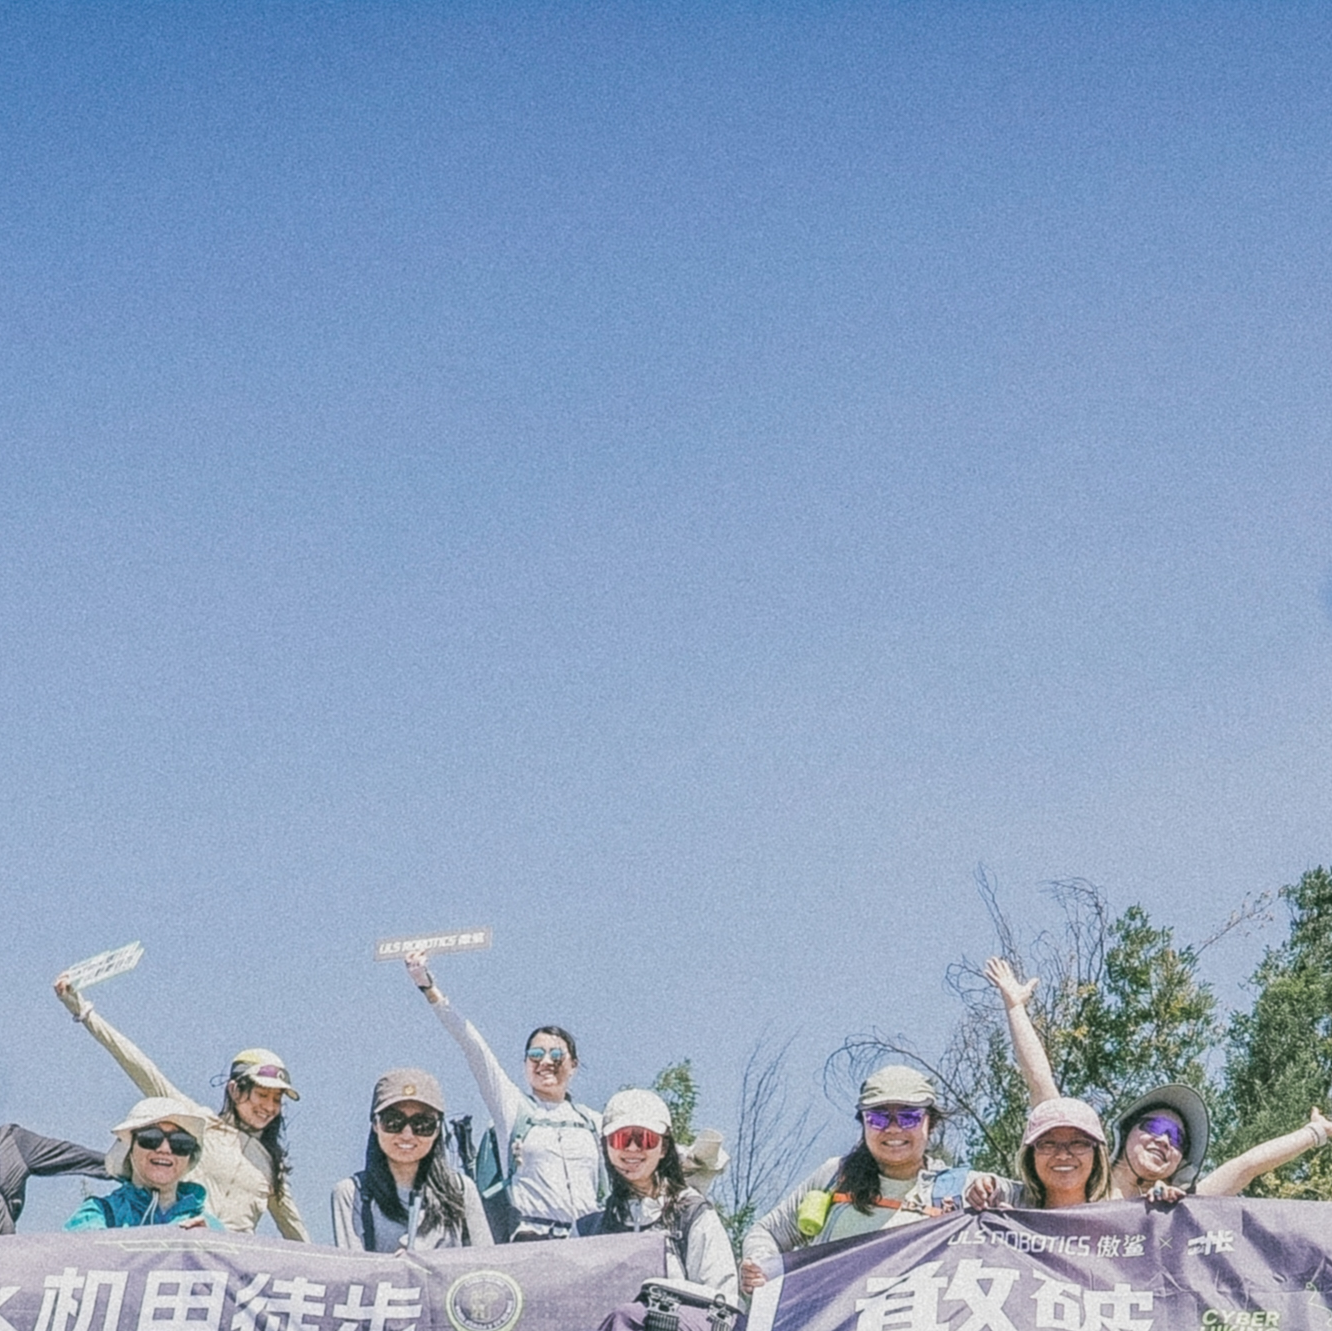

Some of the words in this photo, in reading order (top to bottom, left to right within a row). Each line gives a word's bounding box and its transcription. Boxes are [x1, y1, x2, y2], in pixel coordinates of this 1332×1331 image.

[947, 1230, 987, 1246] ULS
[990, 1230, 1091, 1257] ROBOTICS
[1097, 1234, 1146, 1259] 傲鲨
[1201, 1308, 1280, 1327] CYBER
